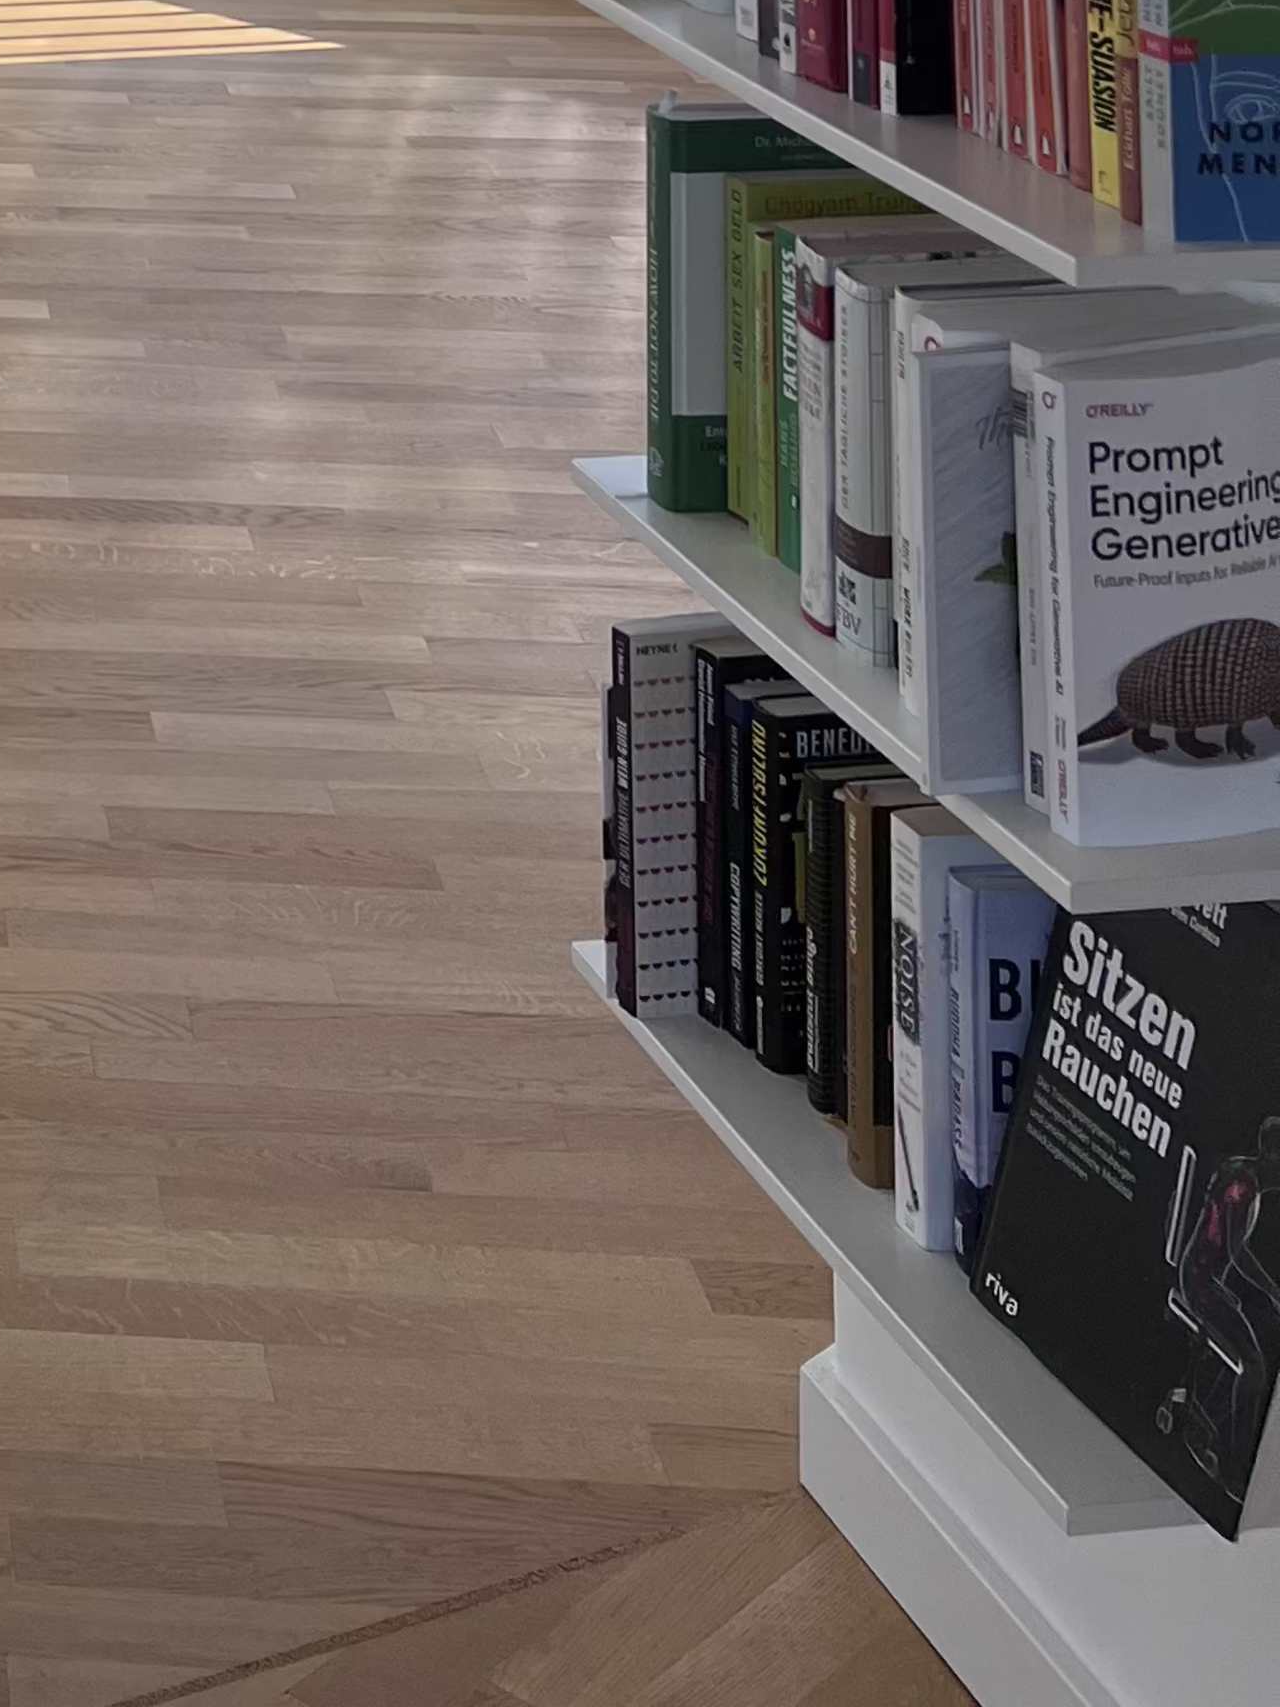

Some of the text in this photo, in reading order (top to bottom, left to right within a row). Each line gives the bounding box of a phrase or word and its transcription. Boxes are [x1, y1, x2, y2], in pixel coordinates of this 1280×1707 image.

[1123, 101, 1136, 172] Eckhart
[648, 247, 660, 301] HOW
[730, 190, 743, 374] ARBEIT SEX GELD
[648, 306, 660, 355] NOT
[783, 247, 797, 402] FACTFULNESS
[1046, 436, 1055, 488] Prompt
[1088, 435, 1224, 478] Prompt
[1089, 469, 1280, 525] Engineering
[1047, 490, 1059, 574] Engineering
[1090, 513, 1280, 561] Generative
[1049, 576, 1059, 595] for
[1092, 570, 1173, 588] Future-Proof
[1175, 566, 1211, 585] Inputs
[1213, 565, 1228, 580] for
[903, 587, 911, 626] WORK
[636, 645, 669, 656] HEYNE
[1050, 597, 1062, 676] Generative
[616, 717, 628, 756] GUIDE
[616, 757, 628, 790] WEIN
[848, 812, 859, 956] CAN'T HURT ME
[728, 862, 741, 970] COPYWRITING
[898, 931, 916, 1035] NOISE
[1062, 919, 1198, 1073] Sitzen
[1052, 982, 1184, 1110] ist das neue
[1041, 1017, 1172, 1160] Rauchen
[984, 1269, 1020, 1318] riva
